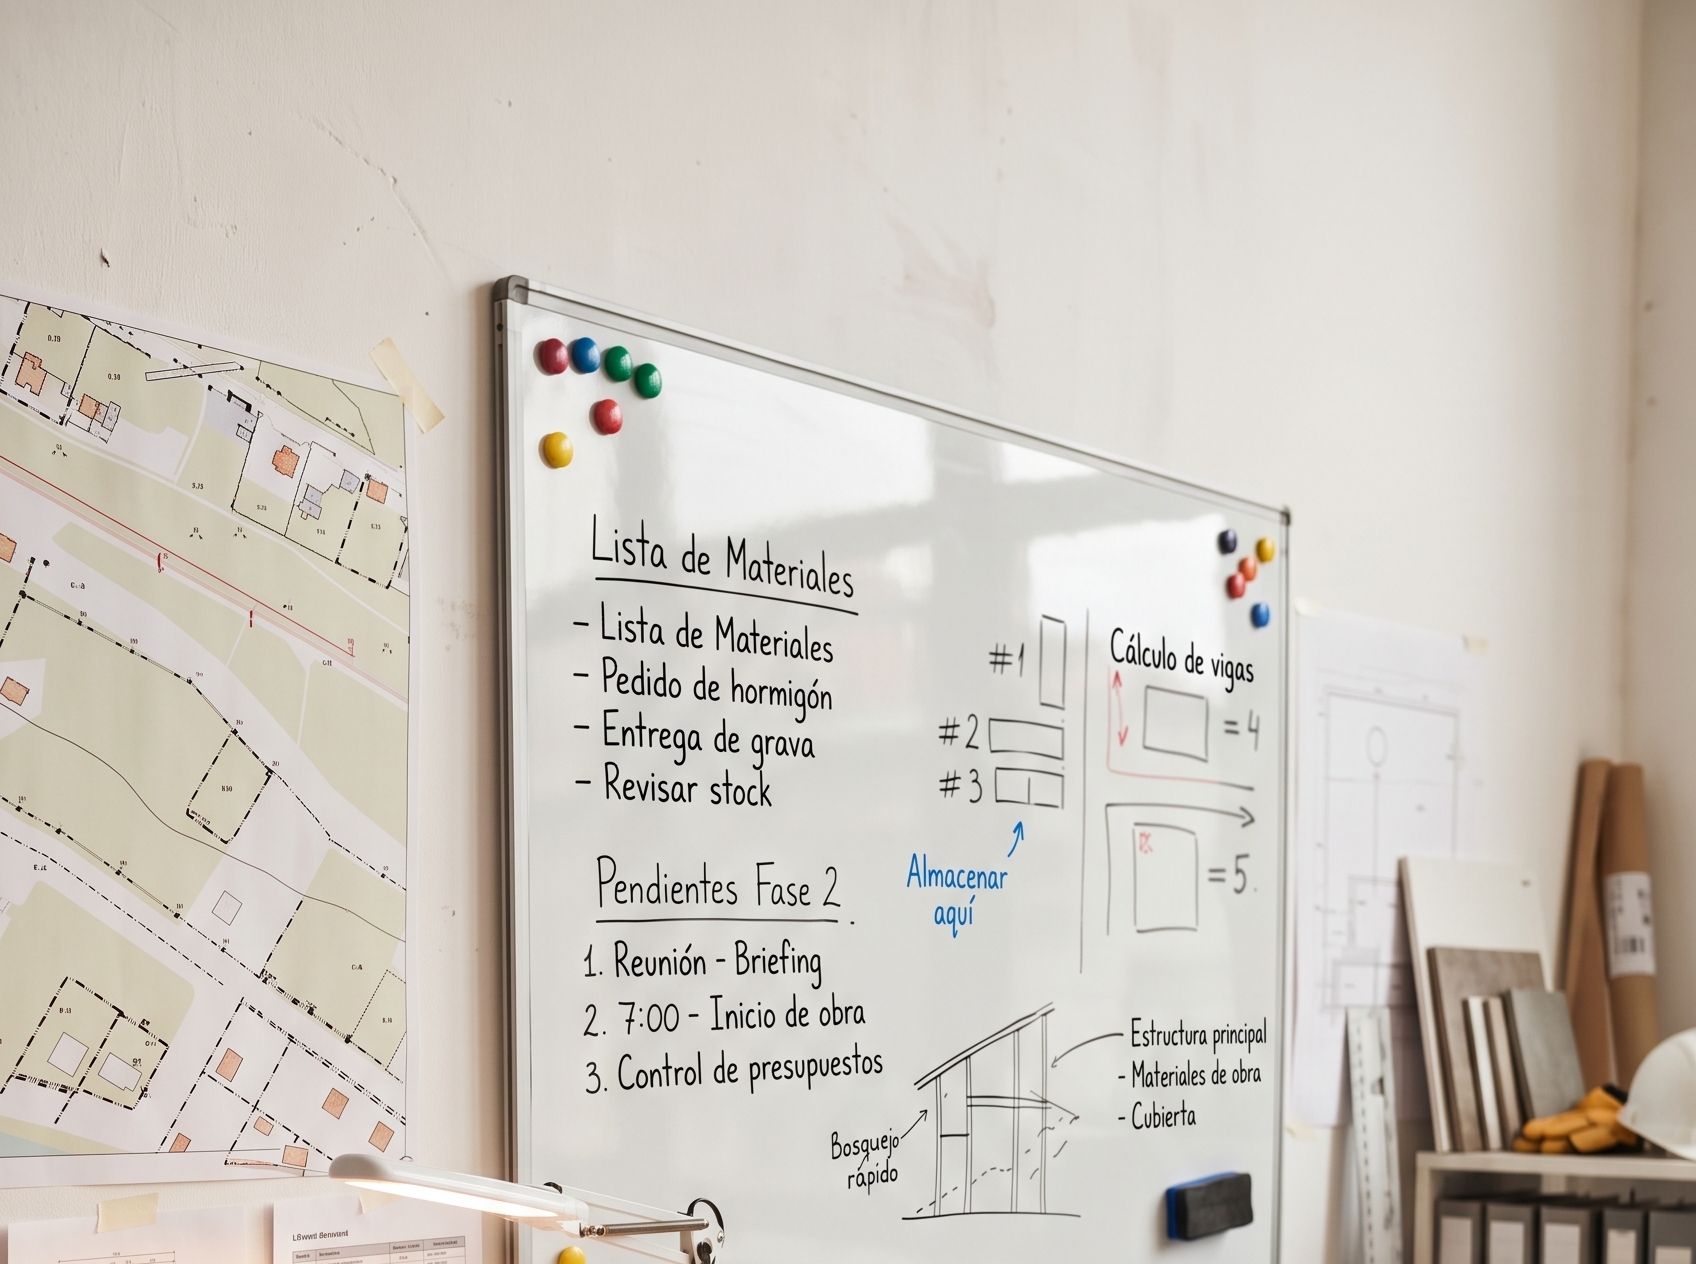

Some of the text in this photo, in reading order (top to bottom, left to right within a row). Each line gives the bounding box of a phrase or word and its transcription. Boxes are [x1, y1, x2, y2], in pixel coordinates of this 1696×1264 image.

[592, 513, 855, 599] Lista de Materiales
[600, 600, 666, 646] Lista
[675, 610, 704, 650] de
[715, 614, 834, 664] Materiales
[1110, 626, 1255, 694] Cálculo de vigas
[601, 655, 682, 699] Pedido
[692, 664, 721, 702] de
[730, 666, 833, 725] hormigón
[602, 708, 703, 767] Entrega
[713, 717, 741, 754] de
[750, 734, 816, 771] grava
[604, 760, 699, 804] Revisar
[709, 768, 772, 807] stock
[596, 854, 842, 909] Pendientes Fase 2
[906, 852, 1009, 890] Almacenar
[933, 894, 976, 939] aquí
[583, 943, 604, 978] 1.
[613, 939, 707, 979] Reunión
[734, 937, 823, 991] Briefing
[582, 1003, 607, 1038] 2.
[617, 1001, 680, 1036] 7:00
[709, 994, 776, 1031] Inicio
[784, 992, 810, 1028] de
[818, 991, 867, 1027] obra
[1130, 1016, 1267, 1056] Estructura principal
[585, 1041, 884, 1095] 3. Control de presupuestos
[1131, 1058, 1207, 1089] Materiales
[1210, 1057, 1228, 1086] de
[1231, 1057, 1262, 1085] obra
[1131, 1098, 1197, 1131] Cubierta
[830, 1127, 900, 1161] Bosquejo
[847, 1157, 899, 1196] rápido
